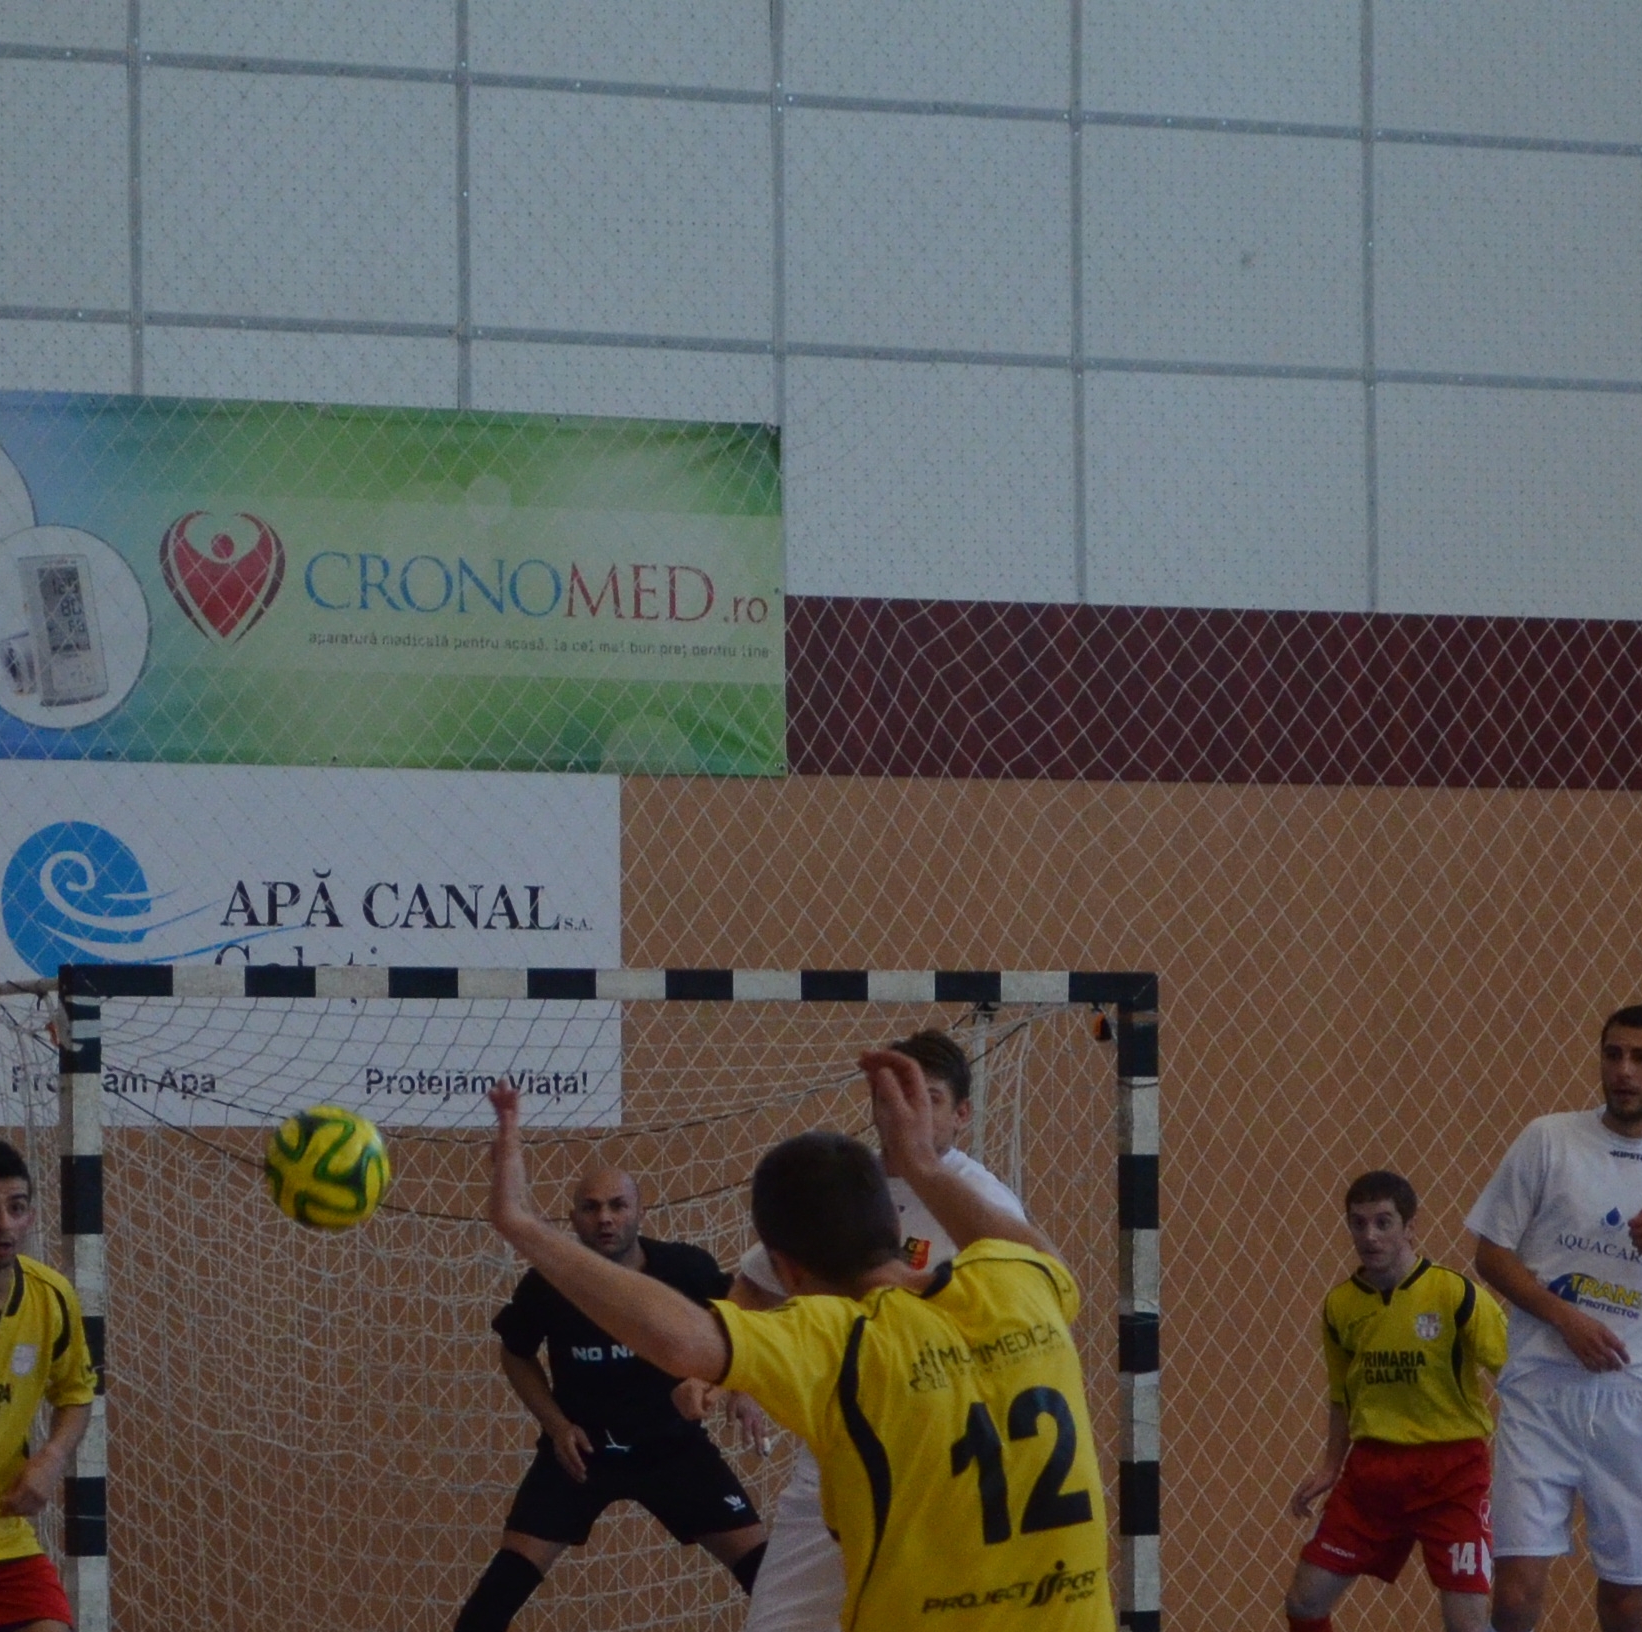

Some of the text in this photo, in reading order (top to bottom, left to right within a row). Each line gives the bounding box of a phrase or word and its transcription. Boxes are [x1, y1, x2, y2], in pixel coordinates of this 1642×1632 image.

[220, 868, 594, 931] APĂ CANAL S.A.
[1364, 1368, 1419, 1385] GALATI
[950, 1385, 1093, 1545] 12
[1447, 1541, 1477, 1576] 14
